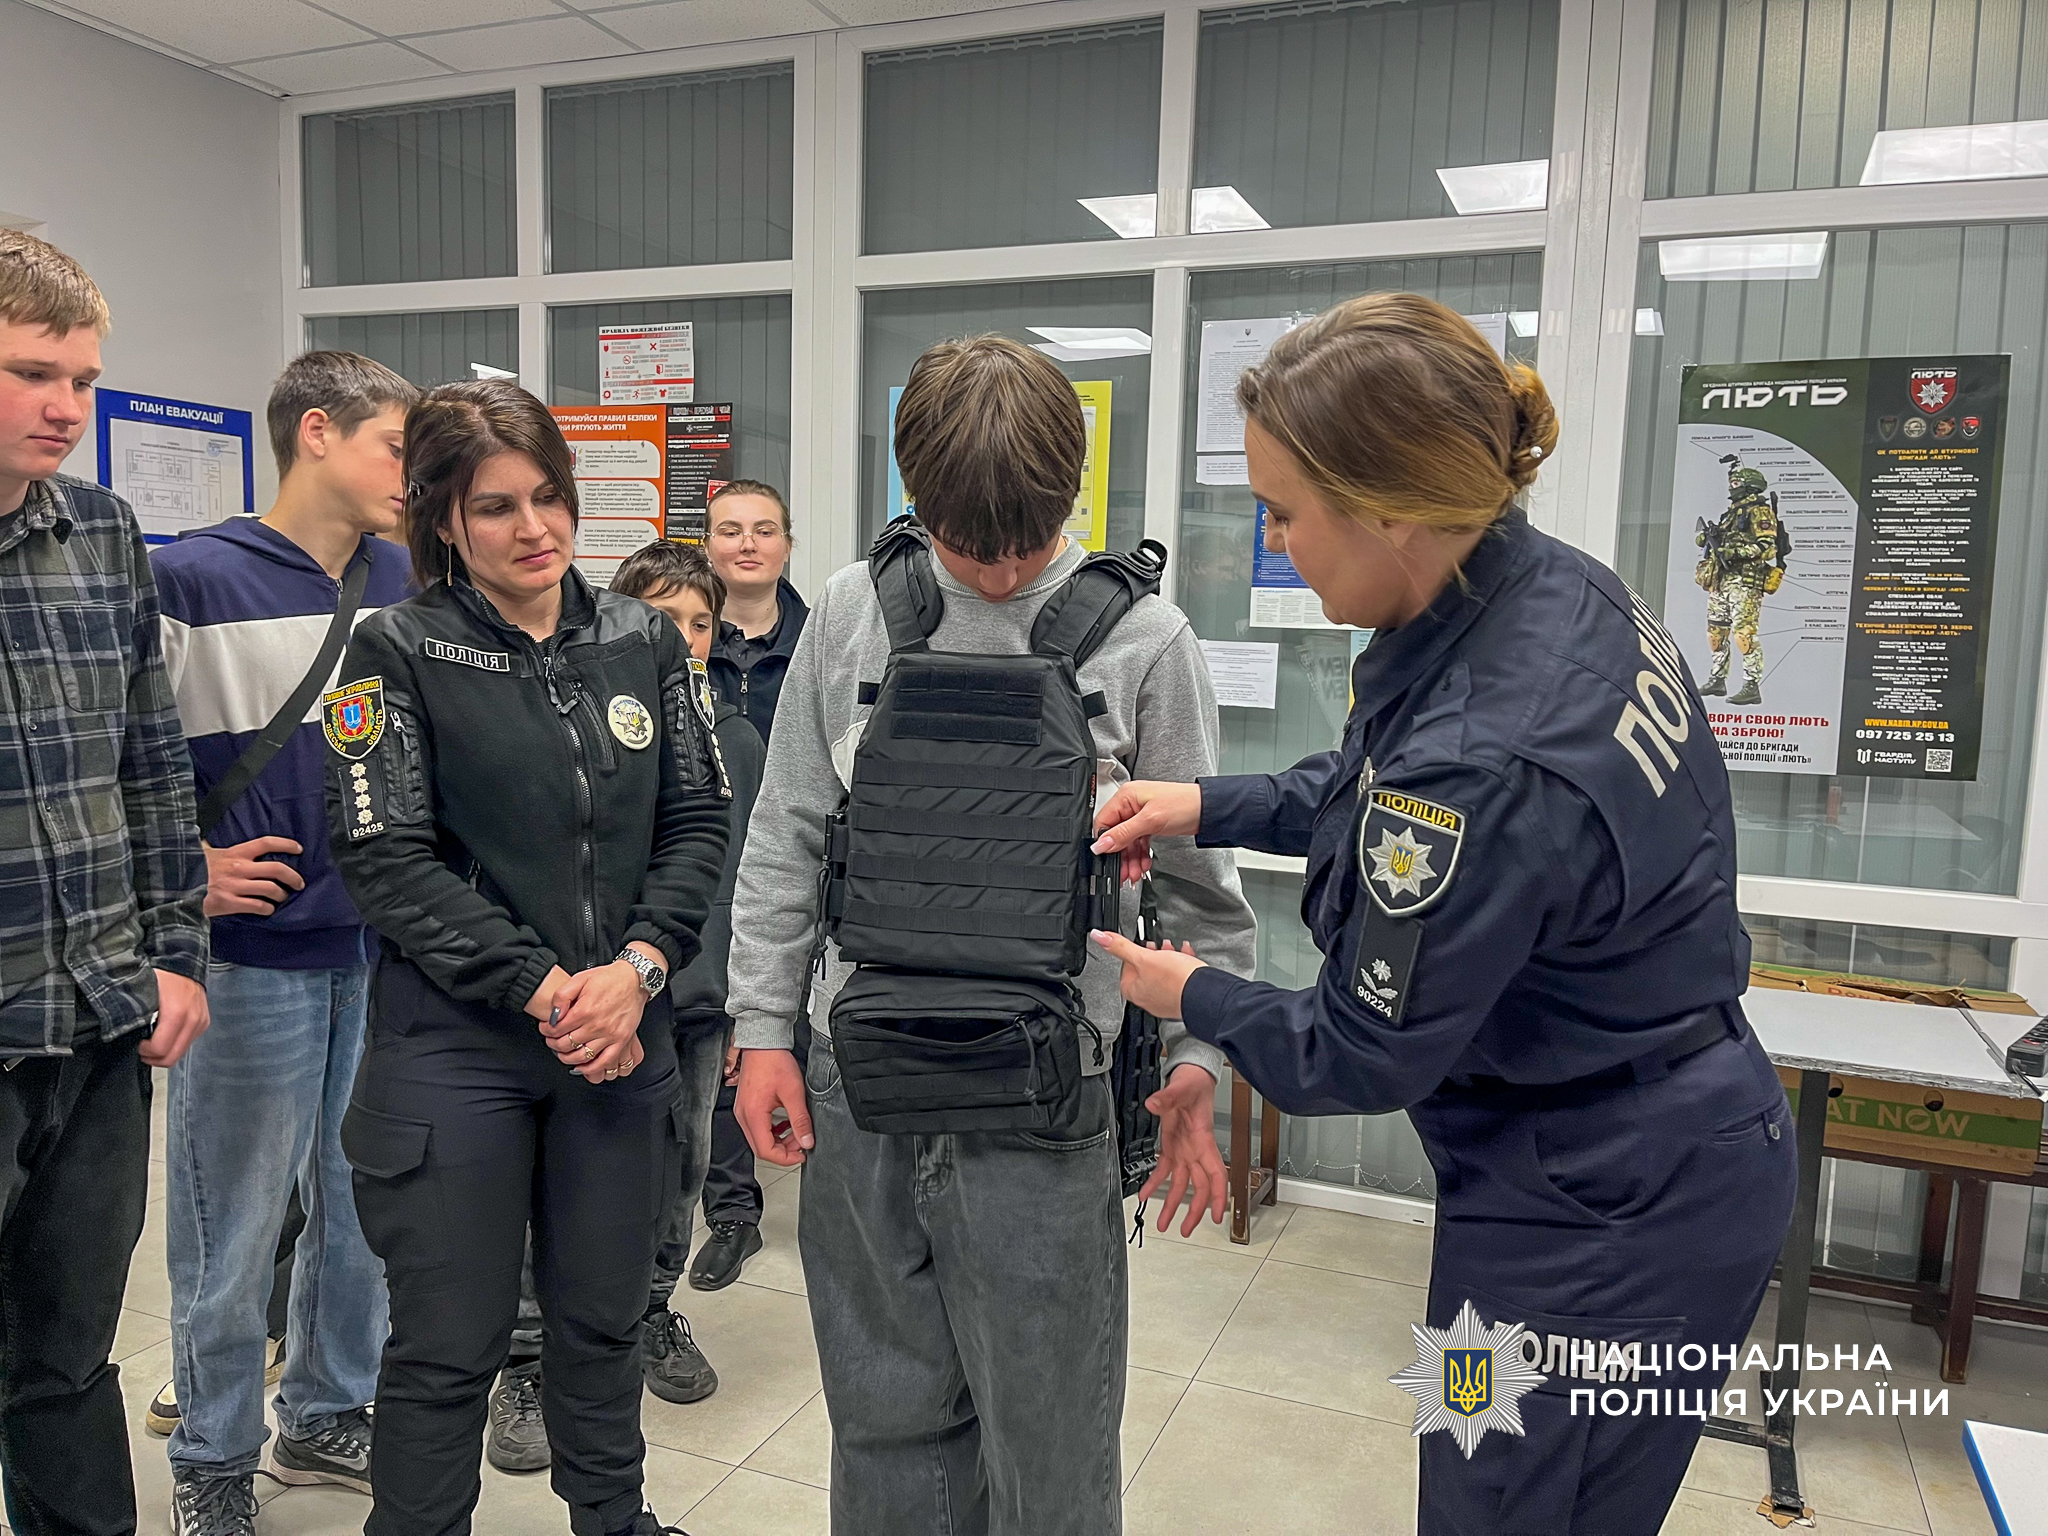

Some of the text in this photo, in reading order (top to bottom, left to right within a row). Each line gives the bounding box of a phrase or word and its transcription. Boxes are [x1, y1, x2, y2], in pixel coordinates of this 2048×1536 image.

[1911, 371, 1957, 379] ЛЮТЬ
[1702, 385, 1848, 409] ЛЮТЬ
[130, 400, 224, 425] ПЛАН ЕВАКУАЦІЇ
[435, 643, 499, 669] ПОЛІЦІЯ
[346, 680, 379, 695] УПРАВЛІННЯ
[367, 709, 382, 745] ОБЛАСТЬ
[1708, 713, 1829, 727] ВОРИ СВОЮ ЛЮТЬ
[1712, 726, 1784, 738] НА ЗБРОЮ!
[326, 723, 346, 752] ОДЕСЬКА
[1746, 742, 1759, 750] ДО
[1760, 743, 1799, 752] БРИГАДИ
[1856, 729, 1954, 742] 097 725 25 13
[1723, 752, 1811, 763] ЬНОЇ ПОЛІЦІЇ «ЛЮТЬ»
[1378, 793, 1456, 829] ПОЛІЦІЯ
[352, 822, 384, 838] 92425
[1357, 985, 1393, 1017] 90224
[1827, 1098, 1970, 1137] AT NOW
[1494, 1321, 1642, 1383] ОЛІЦІЯ
